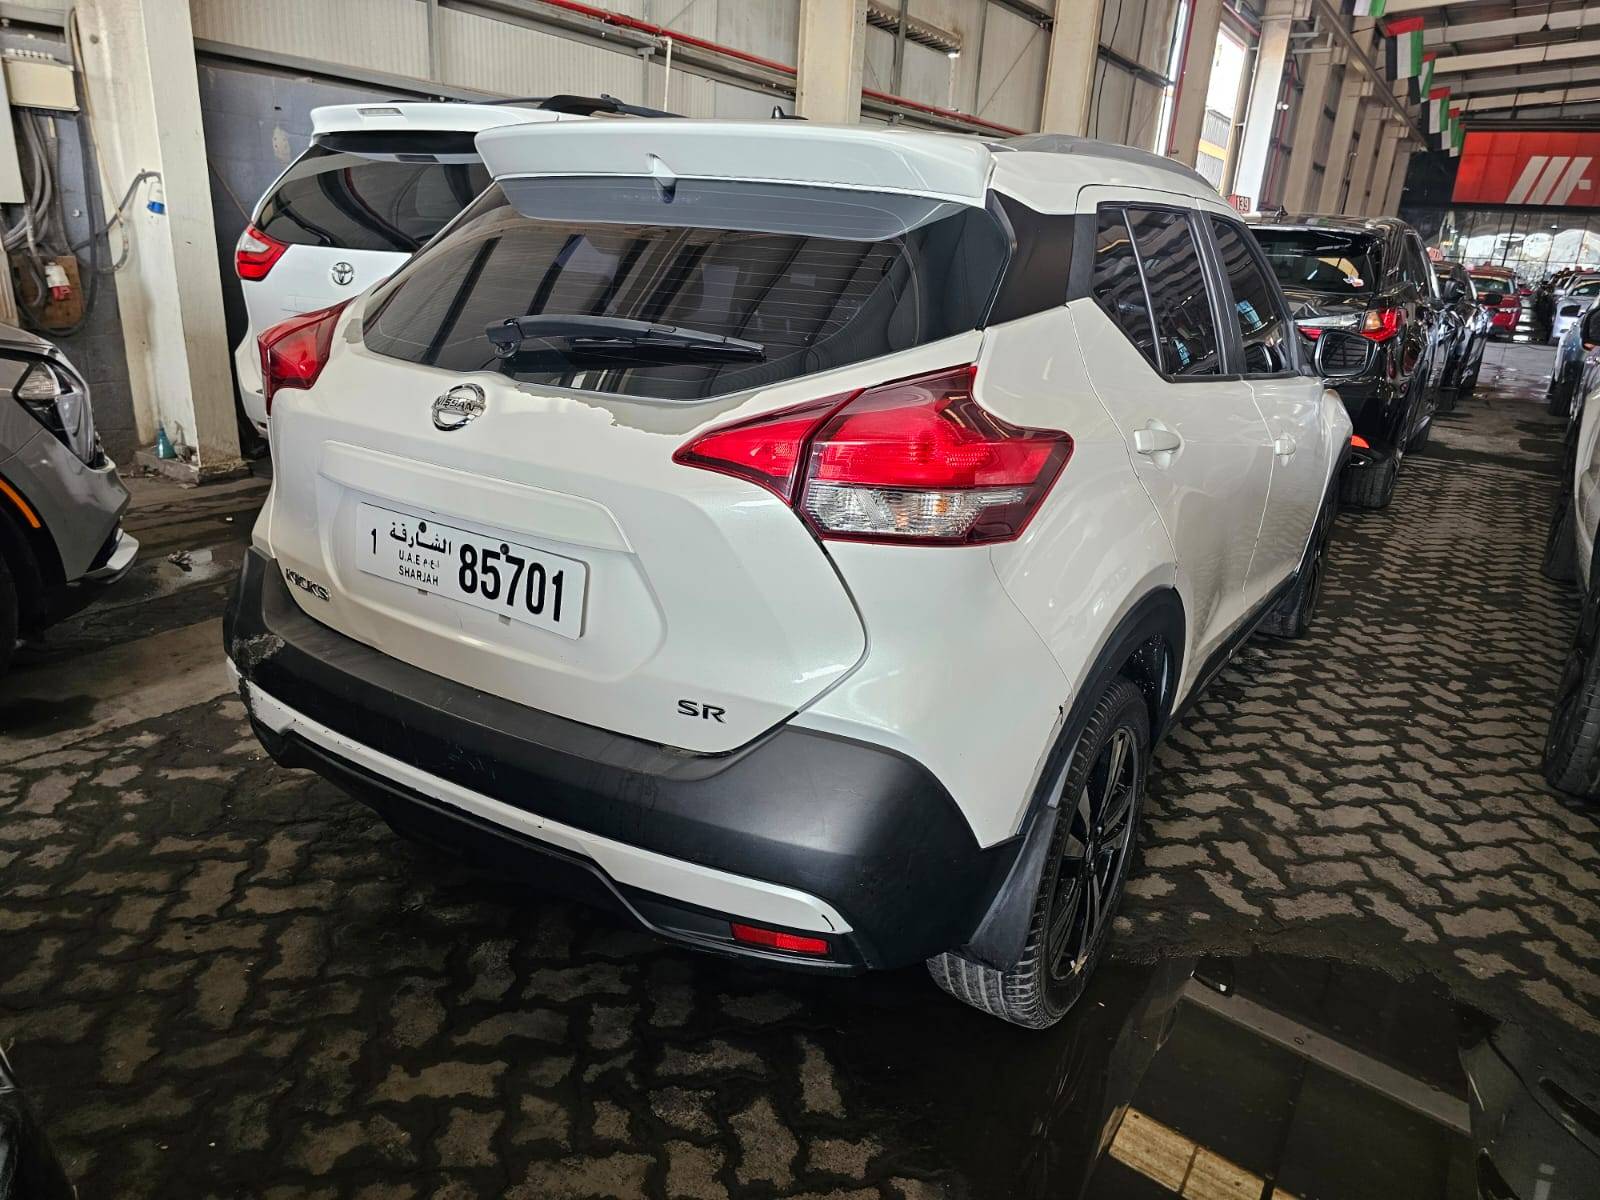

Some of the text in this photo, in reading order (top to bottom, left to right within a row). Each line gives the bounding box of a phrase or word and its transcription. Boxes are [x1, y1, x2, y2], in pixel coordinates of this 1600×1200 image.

[1237, 196, 1249, 211] 139
[436, 396, 475, 412] NISSAN
[389, 521, 452, 556] الشارقة
[285, 567, 330, 602] KICKS
[398, 565, 439, 586] SHARJAH
[458, 543, 564, 622] 85701
[677, 699, 727, 724] SR
